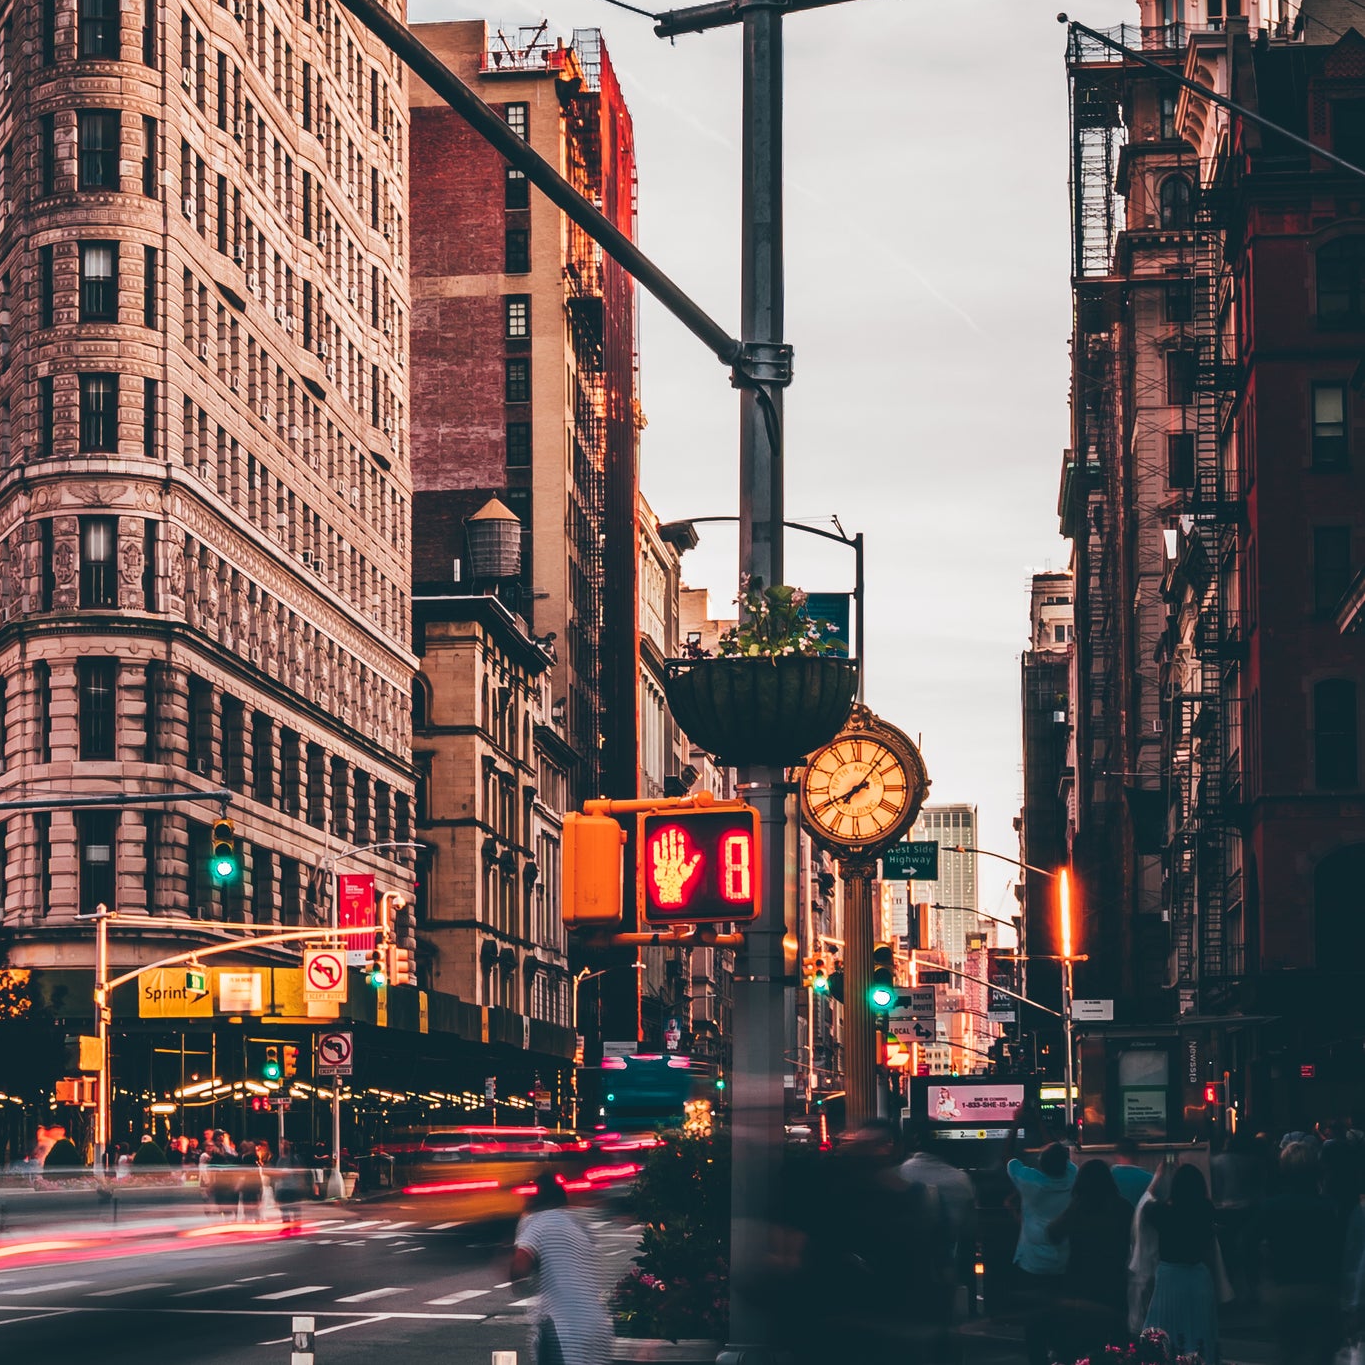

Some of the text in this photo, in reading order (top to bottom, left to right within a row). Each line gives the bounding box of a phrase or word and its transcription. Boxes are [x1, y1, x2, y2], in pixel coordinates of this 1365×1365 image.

[913, 845, 934, 854] Side
[889, 855, 931, 865] Highway
[145, 986, 187, 1002] Sprint
